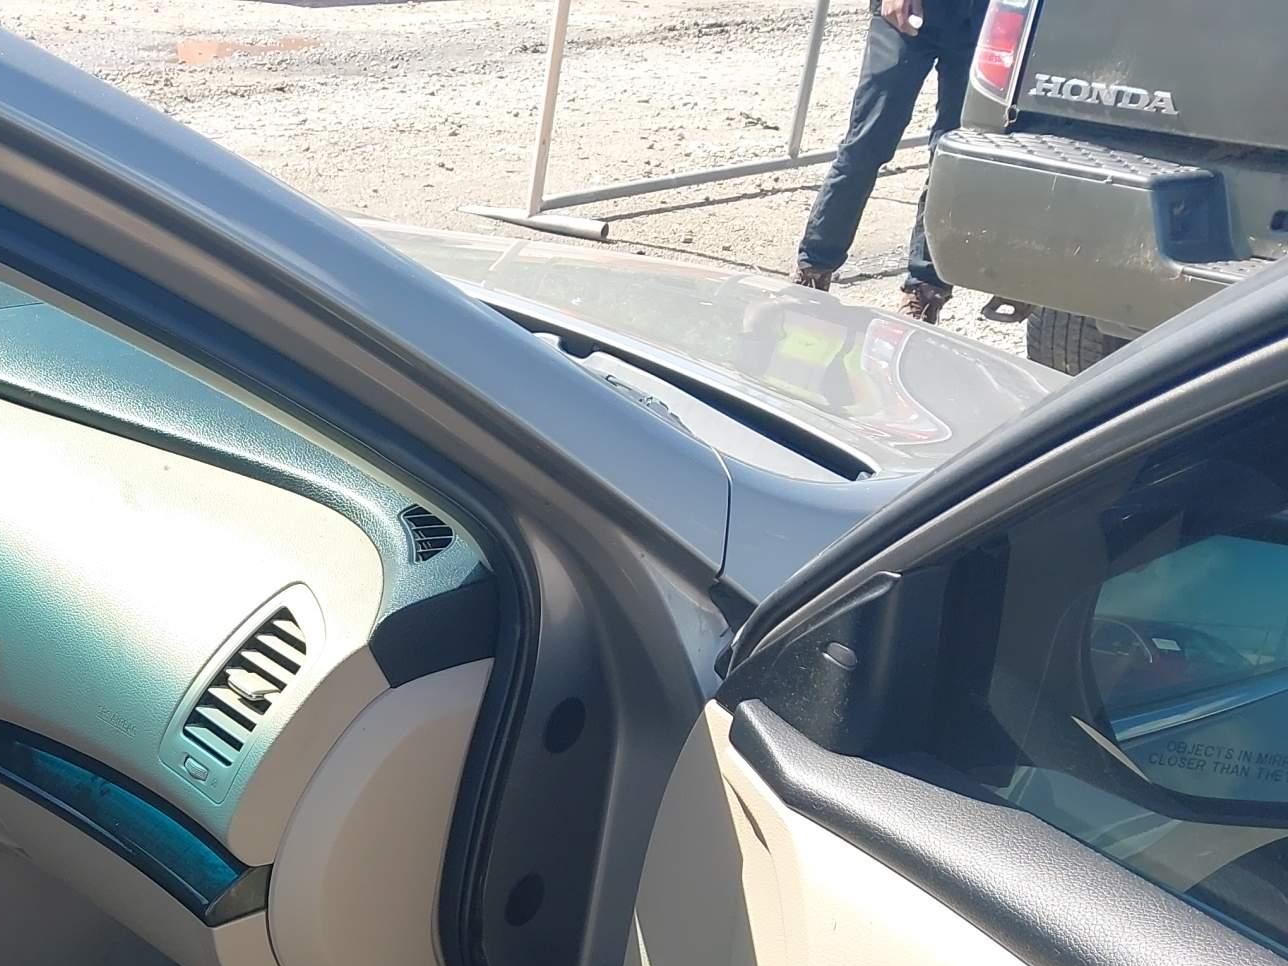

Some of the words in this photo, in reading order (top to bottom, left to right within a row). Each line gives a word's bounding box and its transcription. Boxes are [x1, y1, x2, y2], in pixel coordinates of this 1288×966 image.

[1029, 73, 1179, 115] HONDA
[1167, 739, 1234, 759] OBJECTS
[1238, 749, 1253, 762] IN
[1148, 752, 1207, 771] CLOSER
[1212, 761, 1250, 777] THAN
